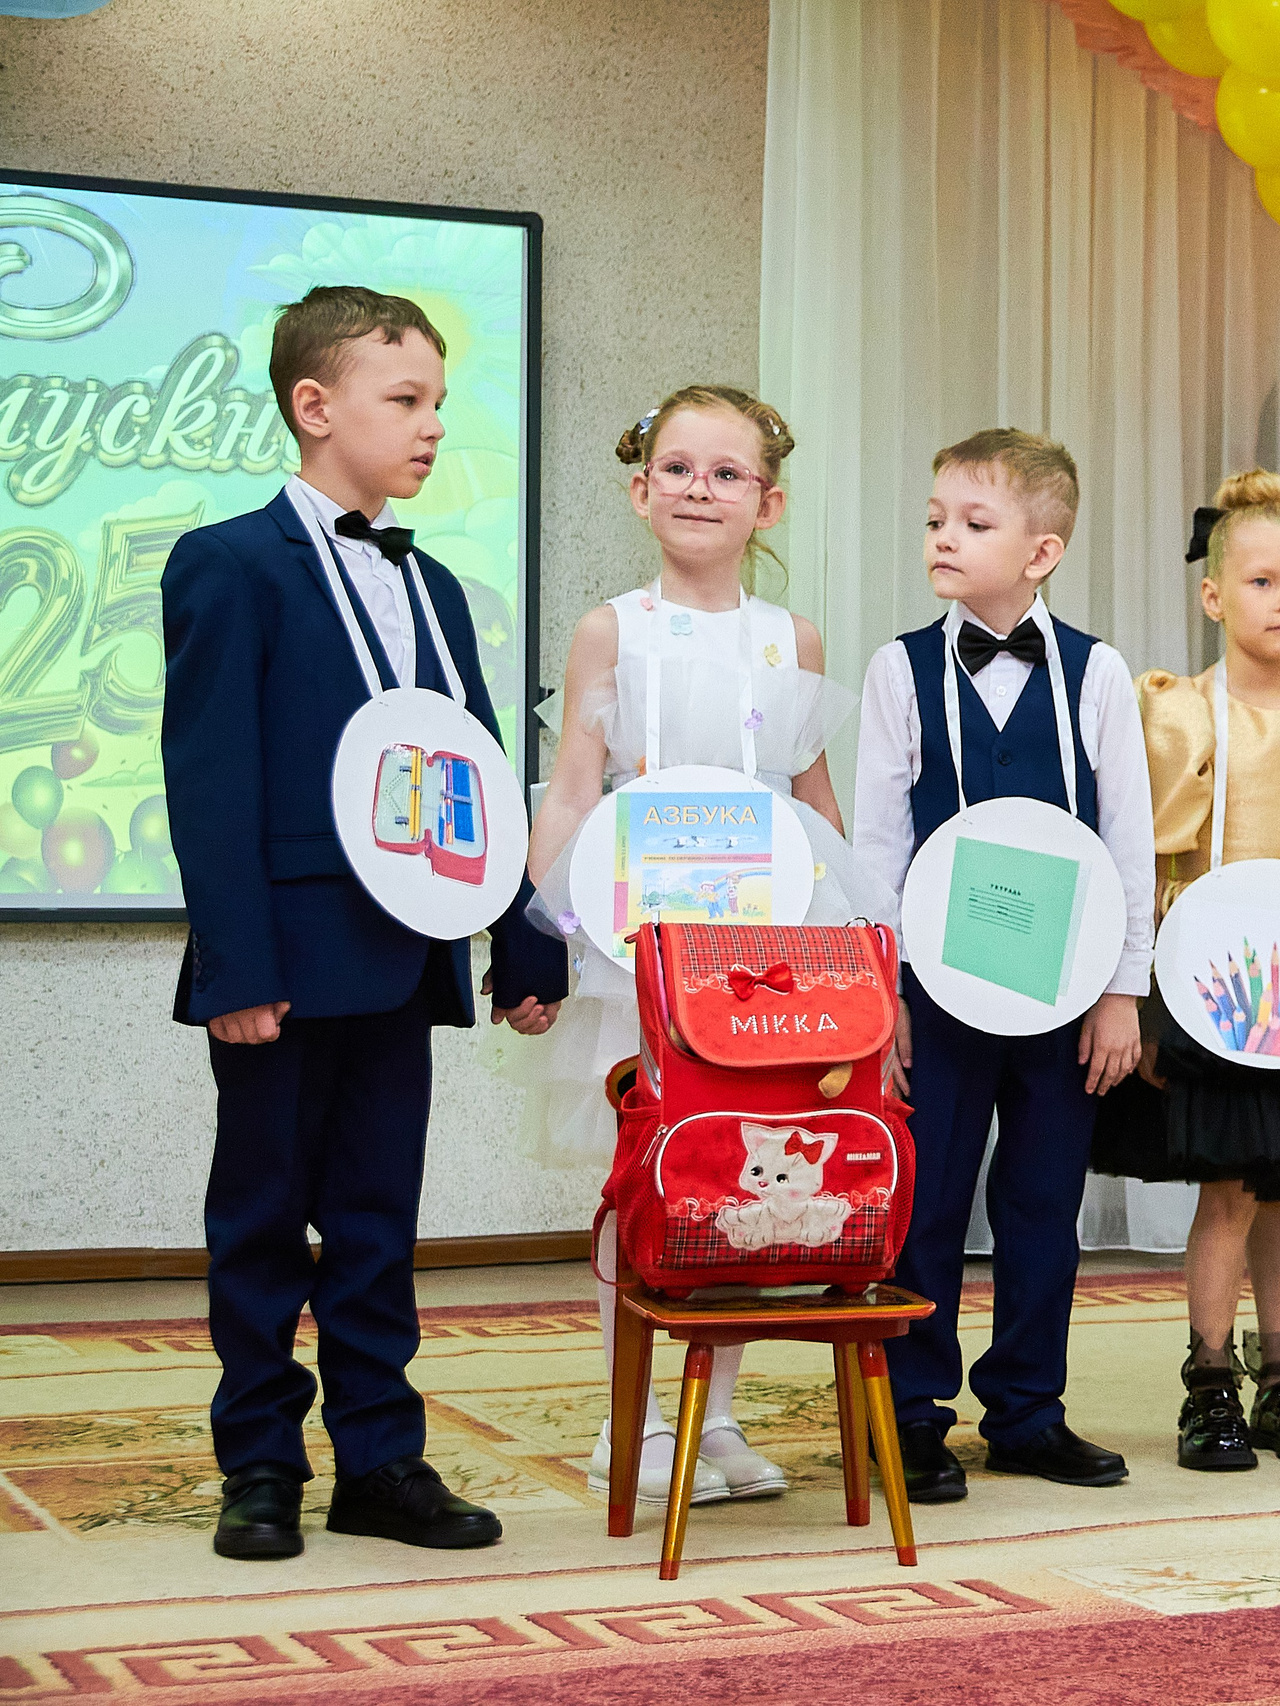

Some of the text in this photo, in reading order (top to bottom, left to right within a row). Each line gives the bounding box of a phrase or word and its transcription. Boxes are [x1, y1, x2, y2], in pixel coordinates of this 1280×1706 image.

[0, 333, 302, 508] ускн
[643, 804, 758, 826] АЗБУКА
[730, 1013, 839, 1035] MIKKA
